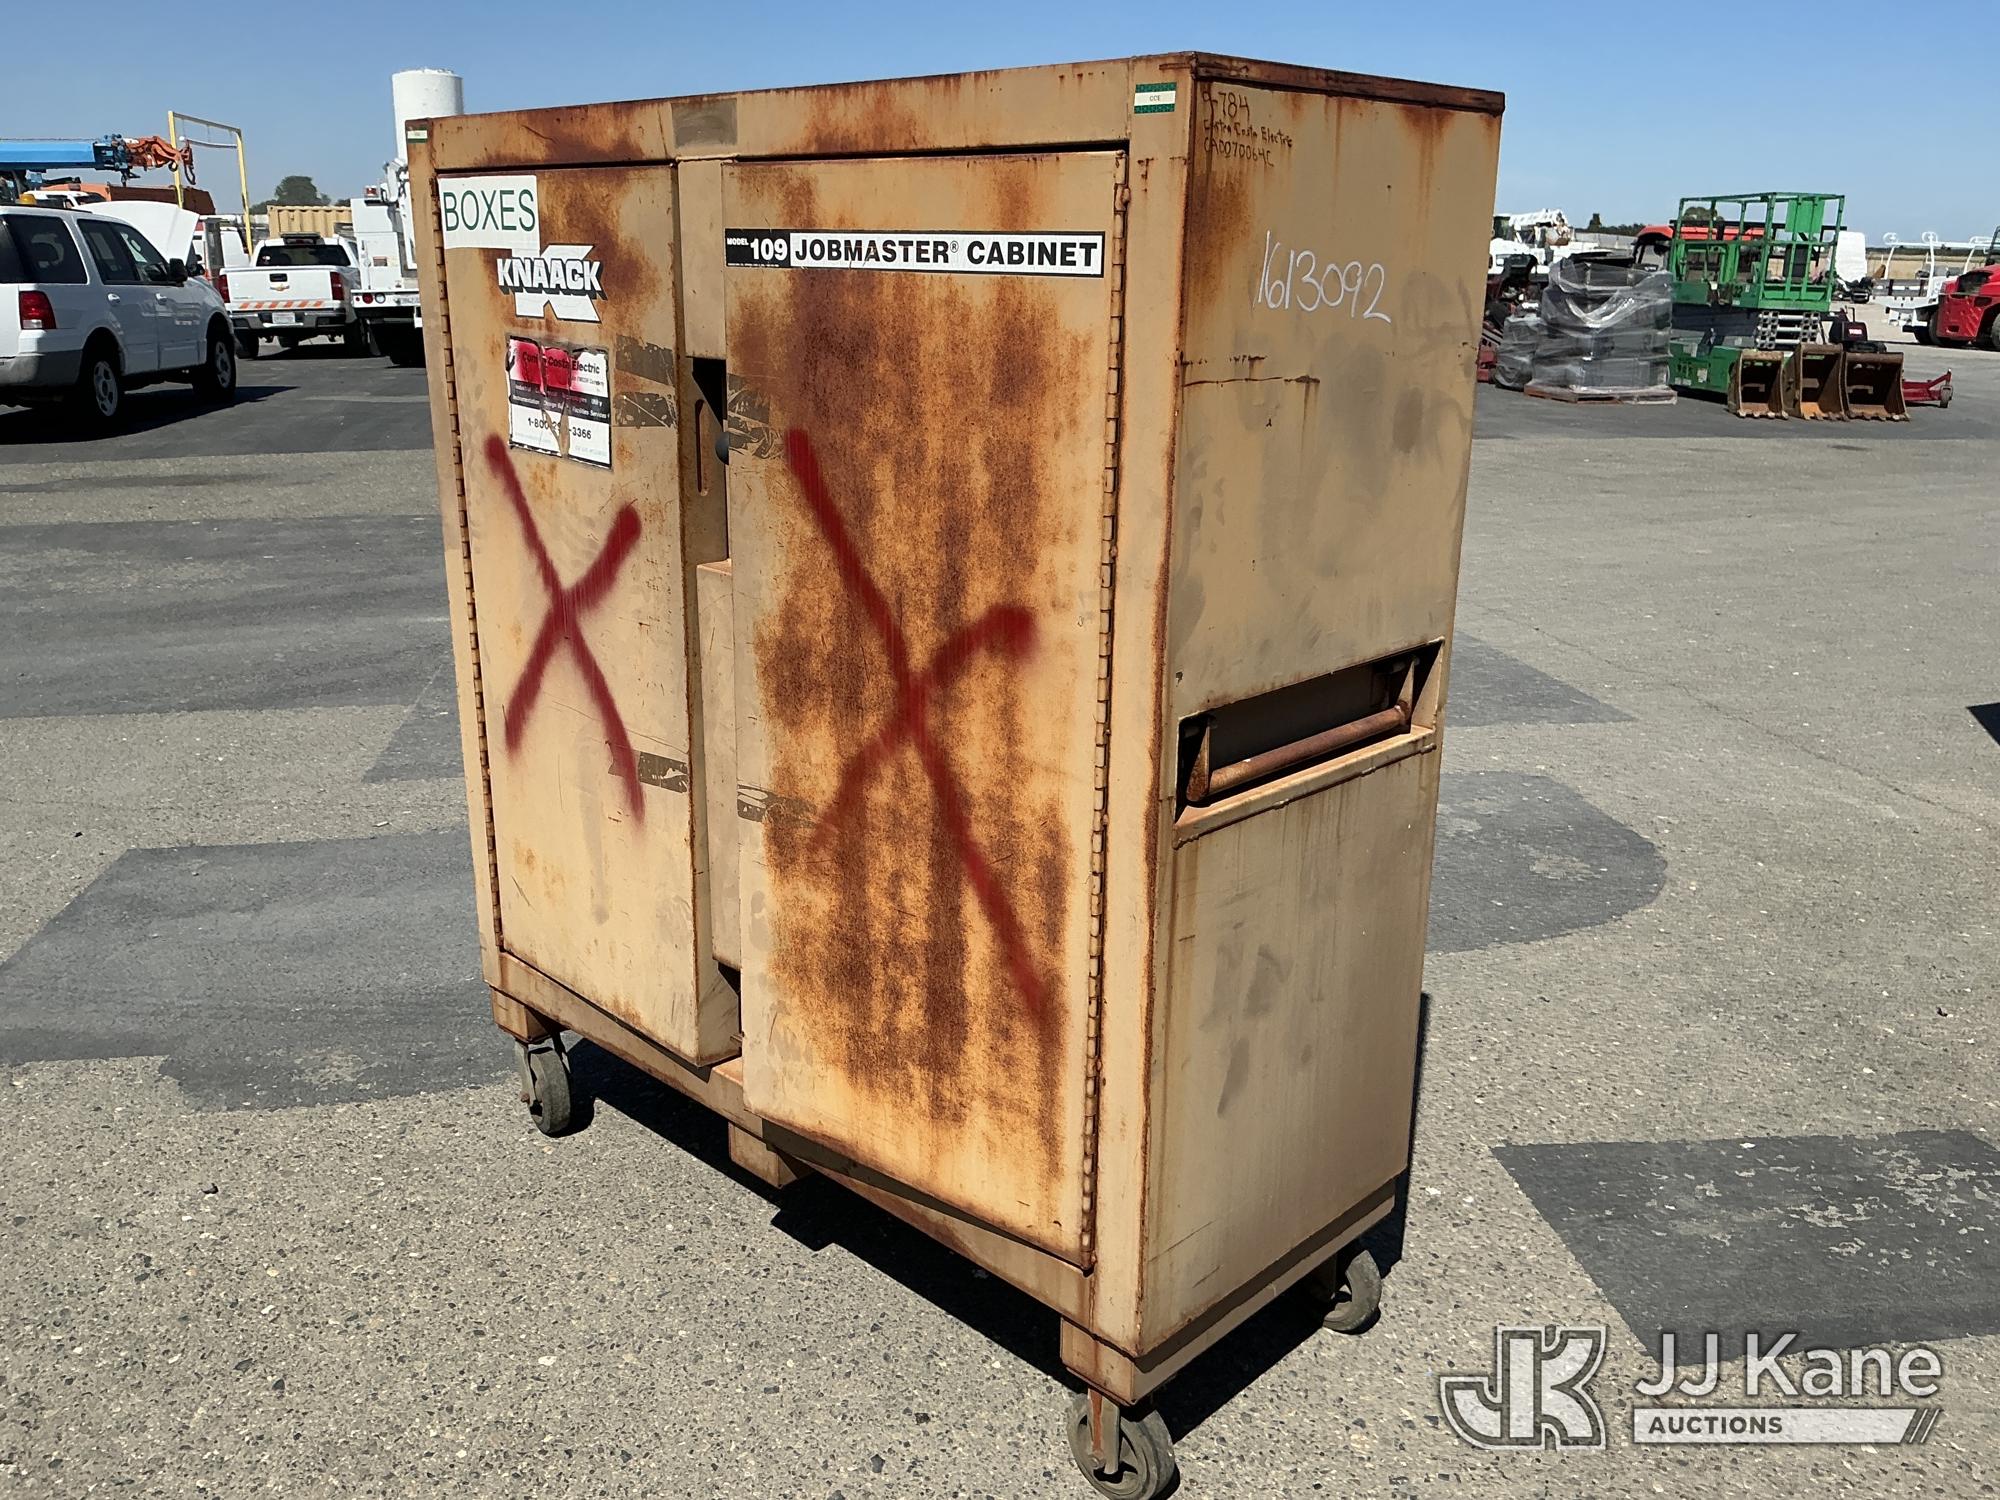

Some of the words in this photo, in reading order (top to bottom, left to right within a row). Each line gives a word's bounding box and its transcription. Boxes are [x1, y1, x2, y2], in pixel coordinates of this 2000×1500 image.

[443, 188, 536, 232] BOXES
[726, 237, 749, 246] MODEL
[750, 238, 788, 261] 109
[966, 240, 1098, 268] CABINET
[496, 257, 607, 300] KNAACK
[1257, 229, 1392, 324] 1613092
[571, 359, 601, 375] Electric
